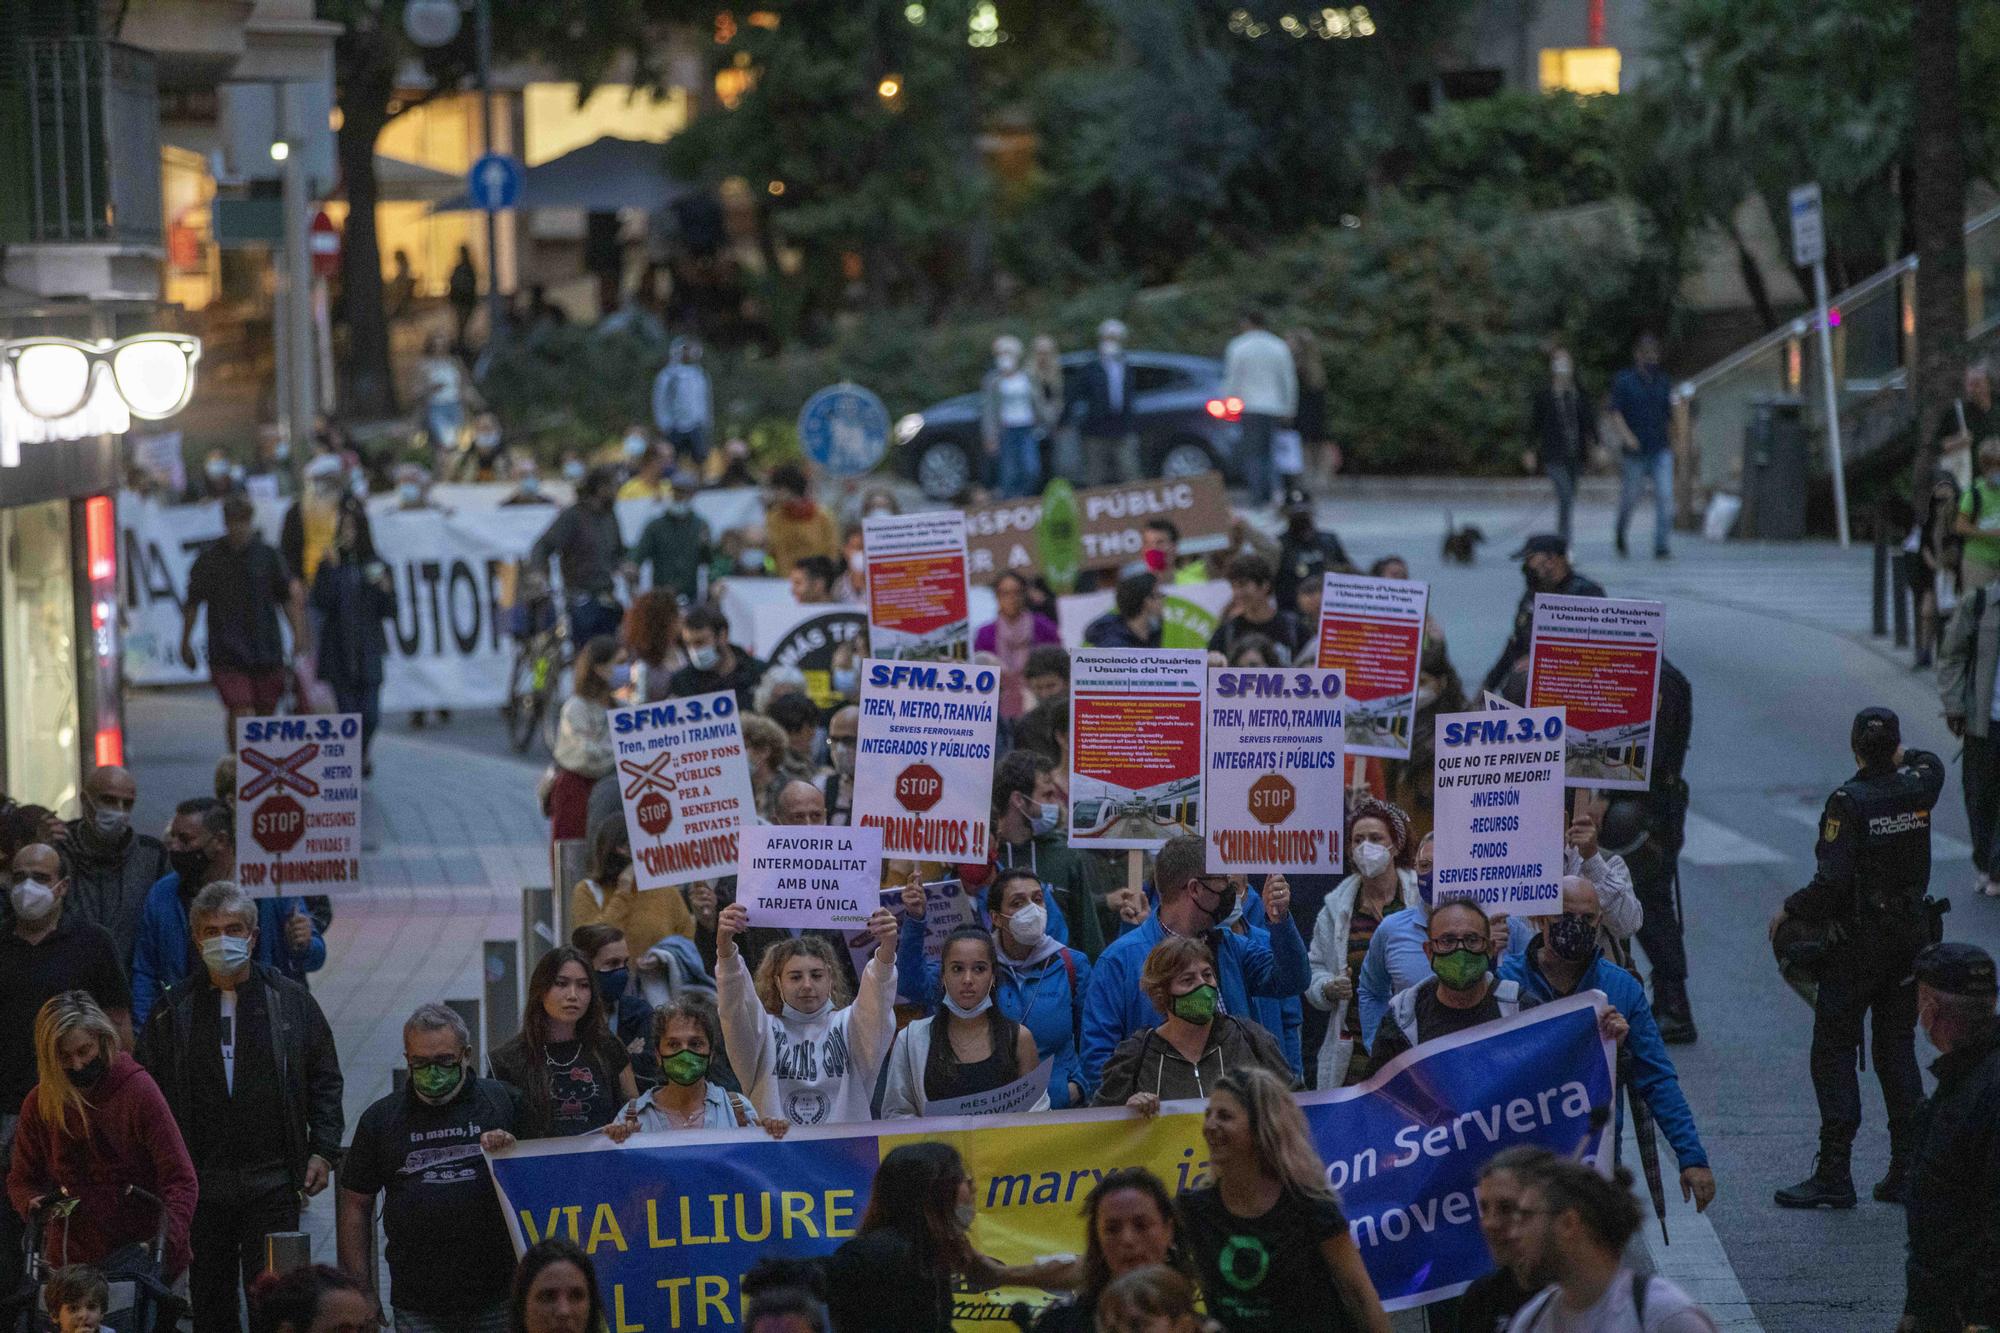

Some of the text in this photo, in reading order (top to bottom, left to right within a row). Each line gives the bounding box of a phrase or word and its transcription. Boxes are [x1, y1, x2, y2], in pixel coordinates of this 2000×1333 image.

[1076, 656, 1138, 664] Associació
[1141, 666, 1158, 674] del
[869, 664, 995, 693] SFM.3.0
[1216, 673, 1342, 698] SFM.3.0
[614, 696, 734, 734] SFM.3.0
[864, 698, 896, 720] TREN,
[1213, 709, 1245, 730] TREN,
[244, 718, 358, 742] SFM.3.0
[618, 740, 645, 755] Tren,
[648, 735, 680, 750] metro
[688, 722, 738, 742] TRAMVIA
[889, 725, 974, 737] SERVEIS FERROVIARIS
[1239, 736, 1323, 744] SERVEIS FERROVIARIS
[1444, 716, 1562, 746] SFM.3.0
[680, 752, 709, 765] STOP
[711, 744, 740, 758] FONS
[861, 738, 990, 759] INTEGRADOS Y PÚBLICOS
[1212, 747, 1336, 769] INTEGRATS i PÚBLICS
[1438, 750, 1560, 771] QUE NO TE PRIVEN DE
[676, 766, 722, 784] PÚBLICS
[1438, 770, 1551, 788] UN FUTURO MEJOR!!
[678, 786, 711, 800] PER A
[901, 778, 939, 795] STOP
[680, 798, 740, 817] BENEFICIS
[1254, 790, 1291, 808] STOP
[257, 811, 300, 835] STOP
[639, 804, 668, 823] STOP
[684, 819, 732, 835] PRIVATS
[1870, 820, 1928, 835] NACIONAL
[306, 838, 343, 854] PRIVADAS
[766, 838, 852, 851] AFAVORIR LA
[240, 864, 266, 886] STOP
[270, 859, 346, 884] CHIRINGUITOS
[752, 858, 867, 871] INTERMODALITAT
[1439, 864, 1542, 884] SERVEIS FERROVIARIS
[777, 878, 839, 890] AMB UNA
[1502, 886, 1509, 902] Y
[1510, 882, 1559, 901] PÚBLICOS
[757, 896, 858, 910] TARJETA ÚNICA
[410, 1121, 480, 1142] En marxa, ja
[1394, 1080, 1592, 1168] Servera
[520, 1189, 857, 1255] VIA LLIURE
[657, 1275, 749, 1329] TR
[1349, 1186, 1484, 1250] nove
